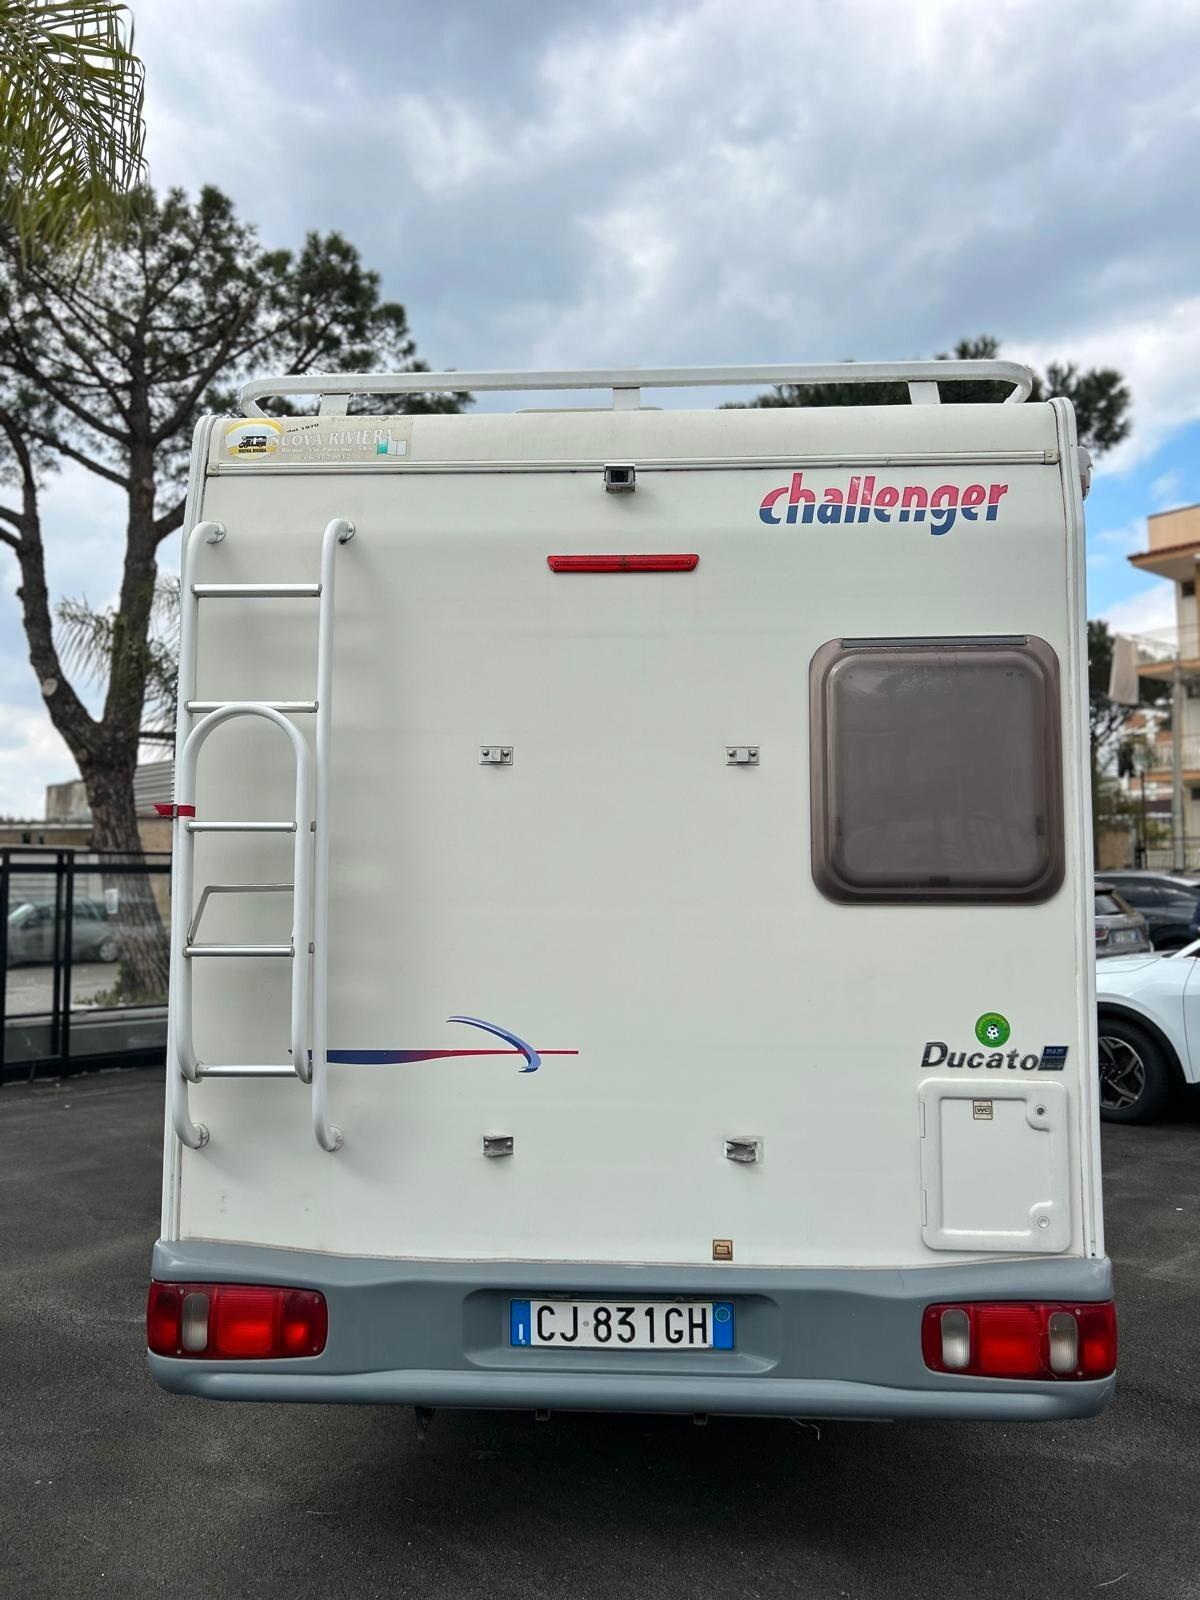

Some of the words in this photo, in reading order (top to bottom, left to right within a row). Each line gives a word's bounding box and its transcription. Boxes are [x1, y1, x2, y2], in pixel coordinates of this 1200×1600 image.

[269, 433, 322, 446] NUOVA
[328, 428, 393, 445] RIVIERA
[920, 1041, 1039, 1071] Ducato
